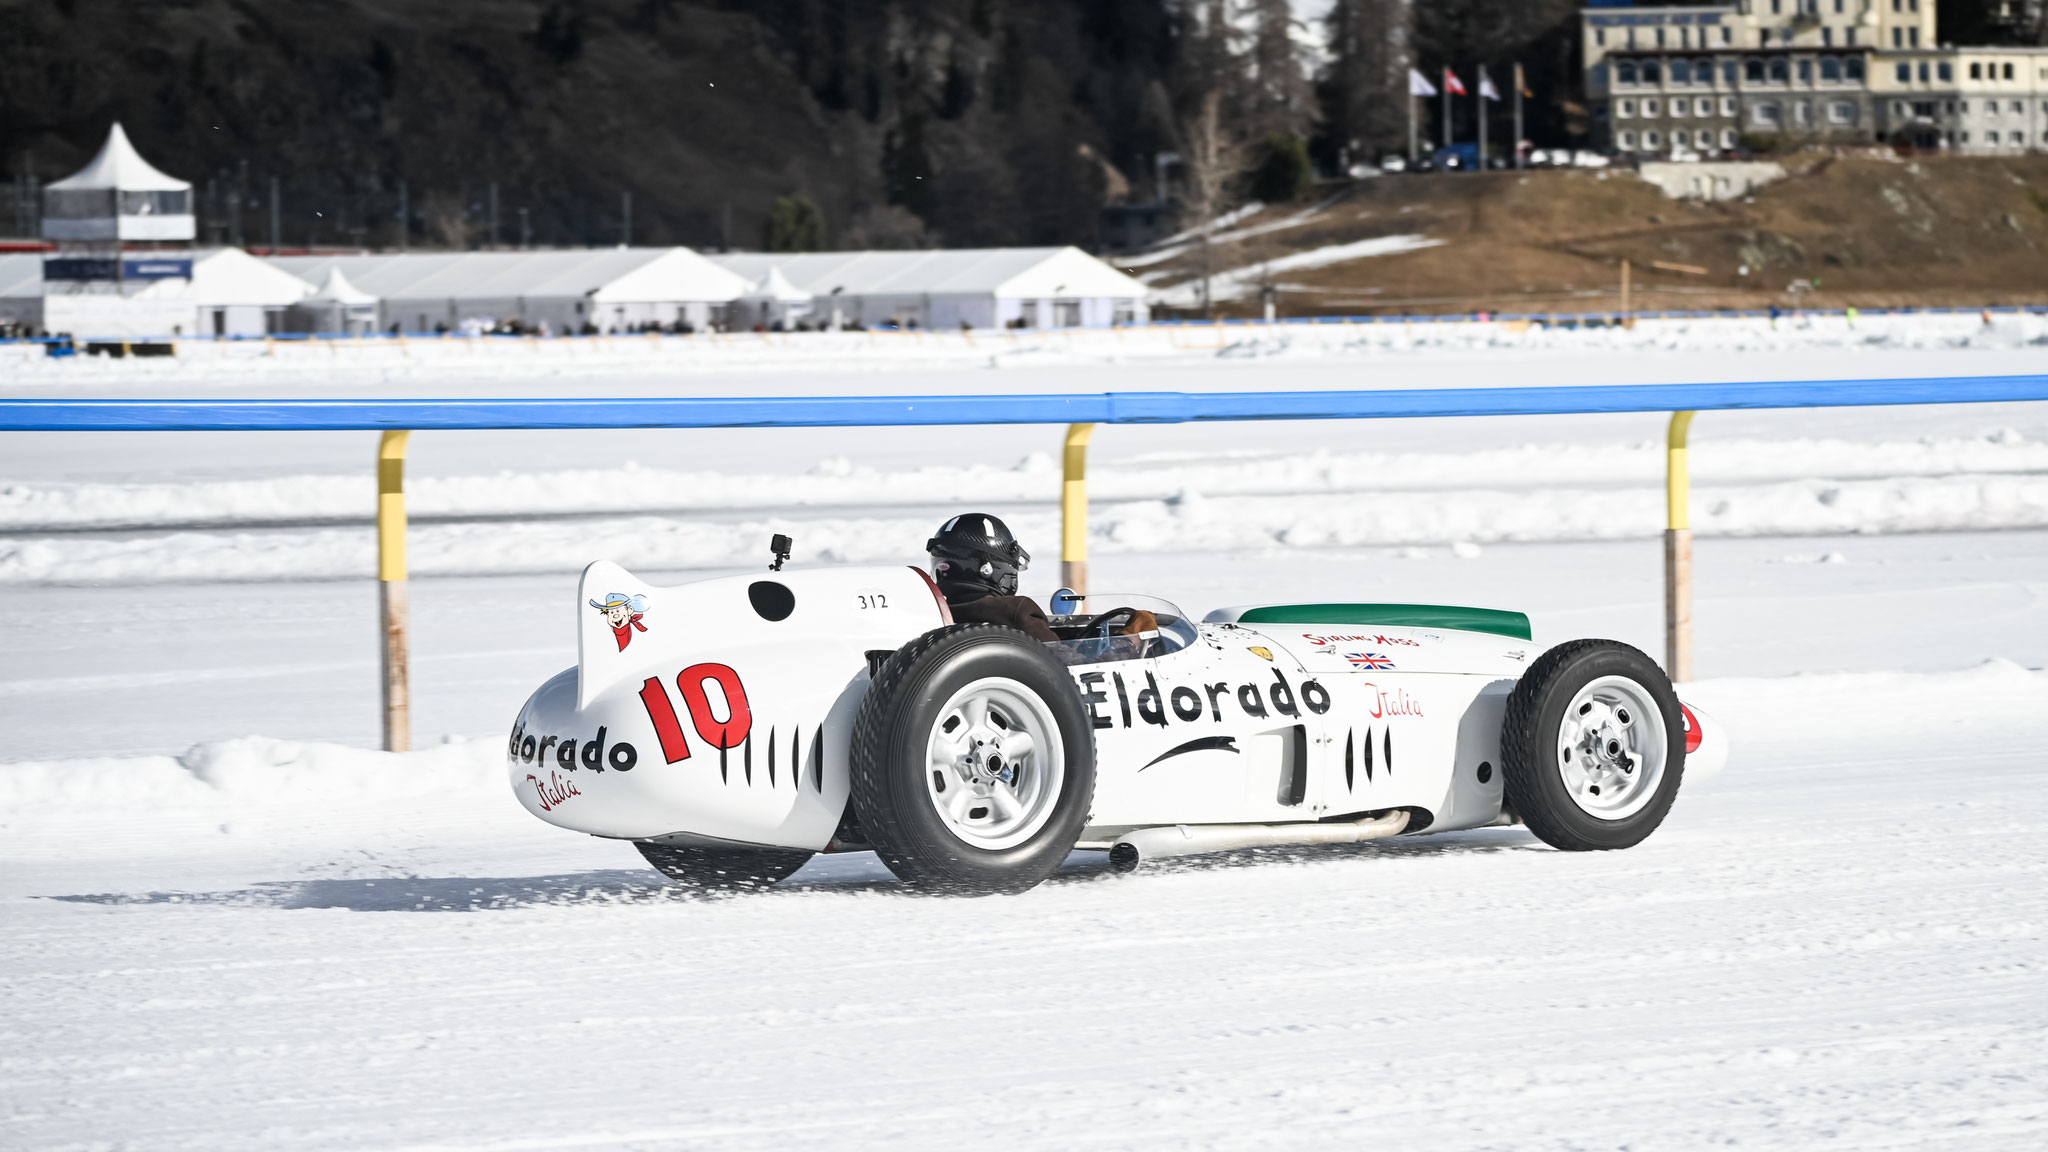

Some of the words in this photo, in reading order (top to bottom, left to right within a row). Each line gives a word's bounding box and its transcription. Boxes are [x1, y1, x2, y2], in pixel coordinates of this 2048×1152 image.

[857, 594, 889, 610] 312
[638, 662, 753, 765] 10
[1079, 666, 1332, 730] Eldorado
[1364, 682, 1424, 719] Italia
[509, 725, 638, 774] dorado
[526, 769, 582, 812] Italia
